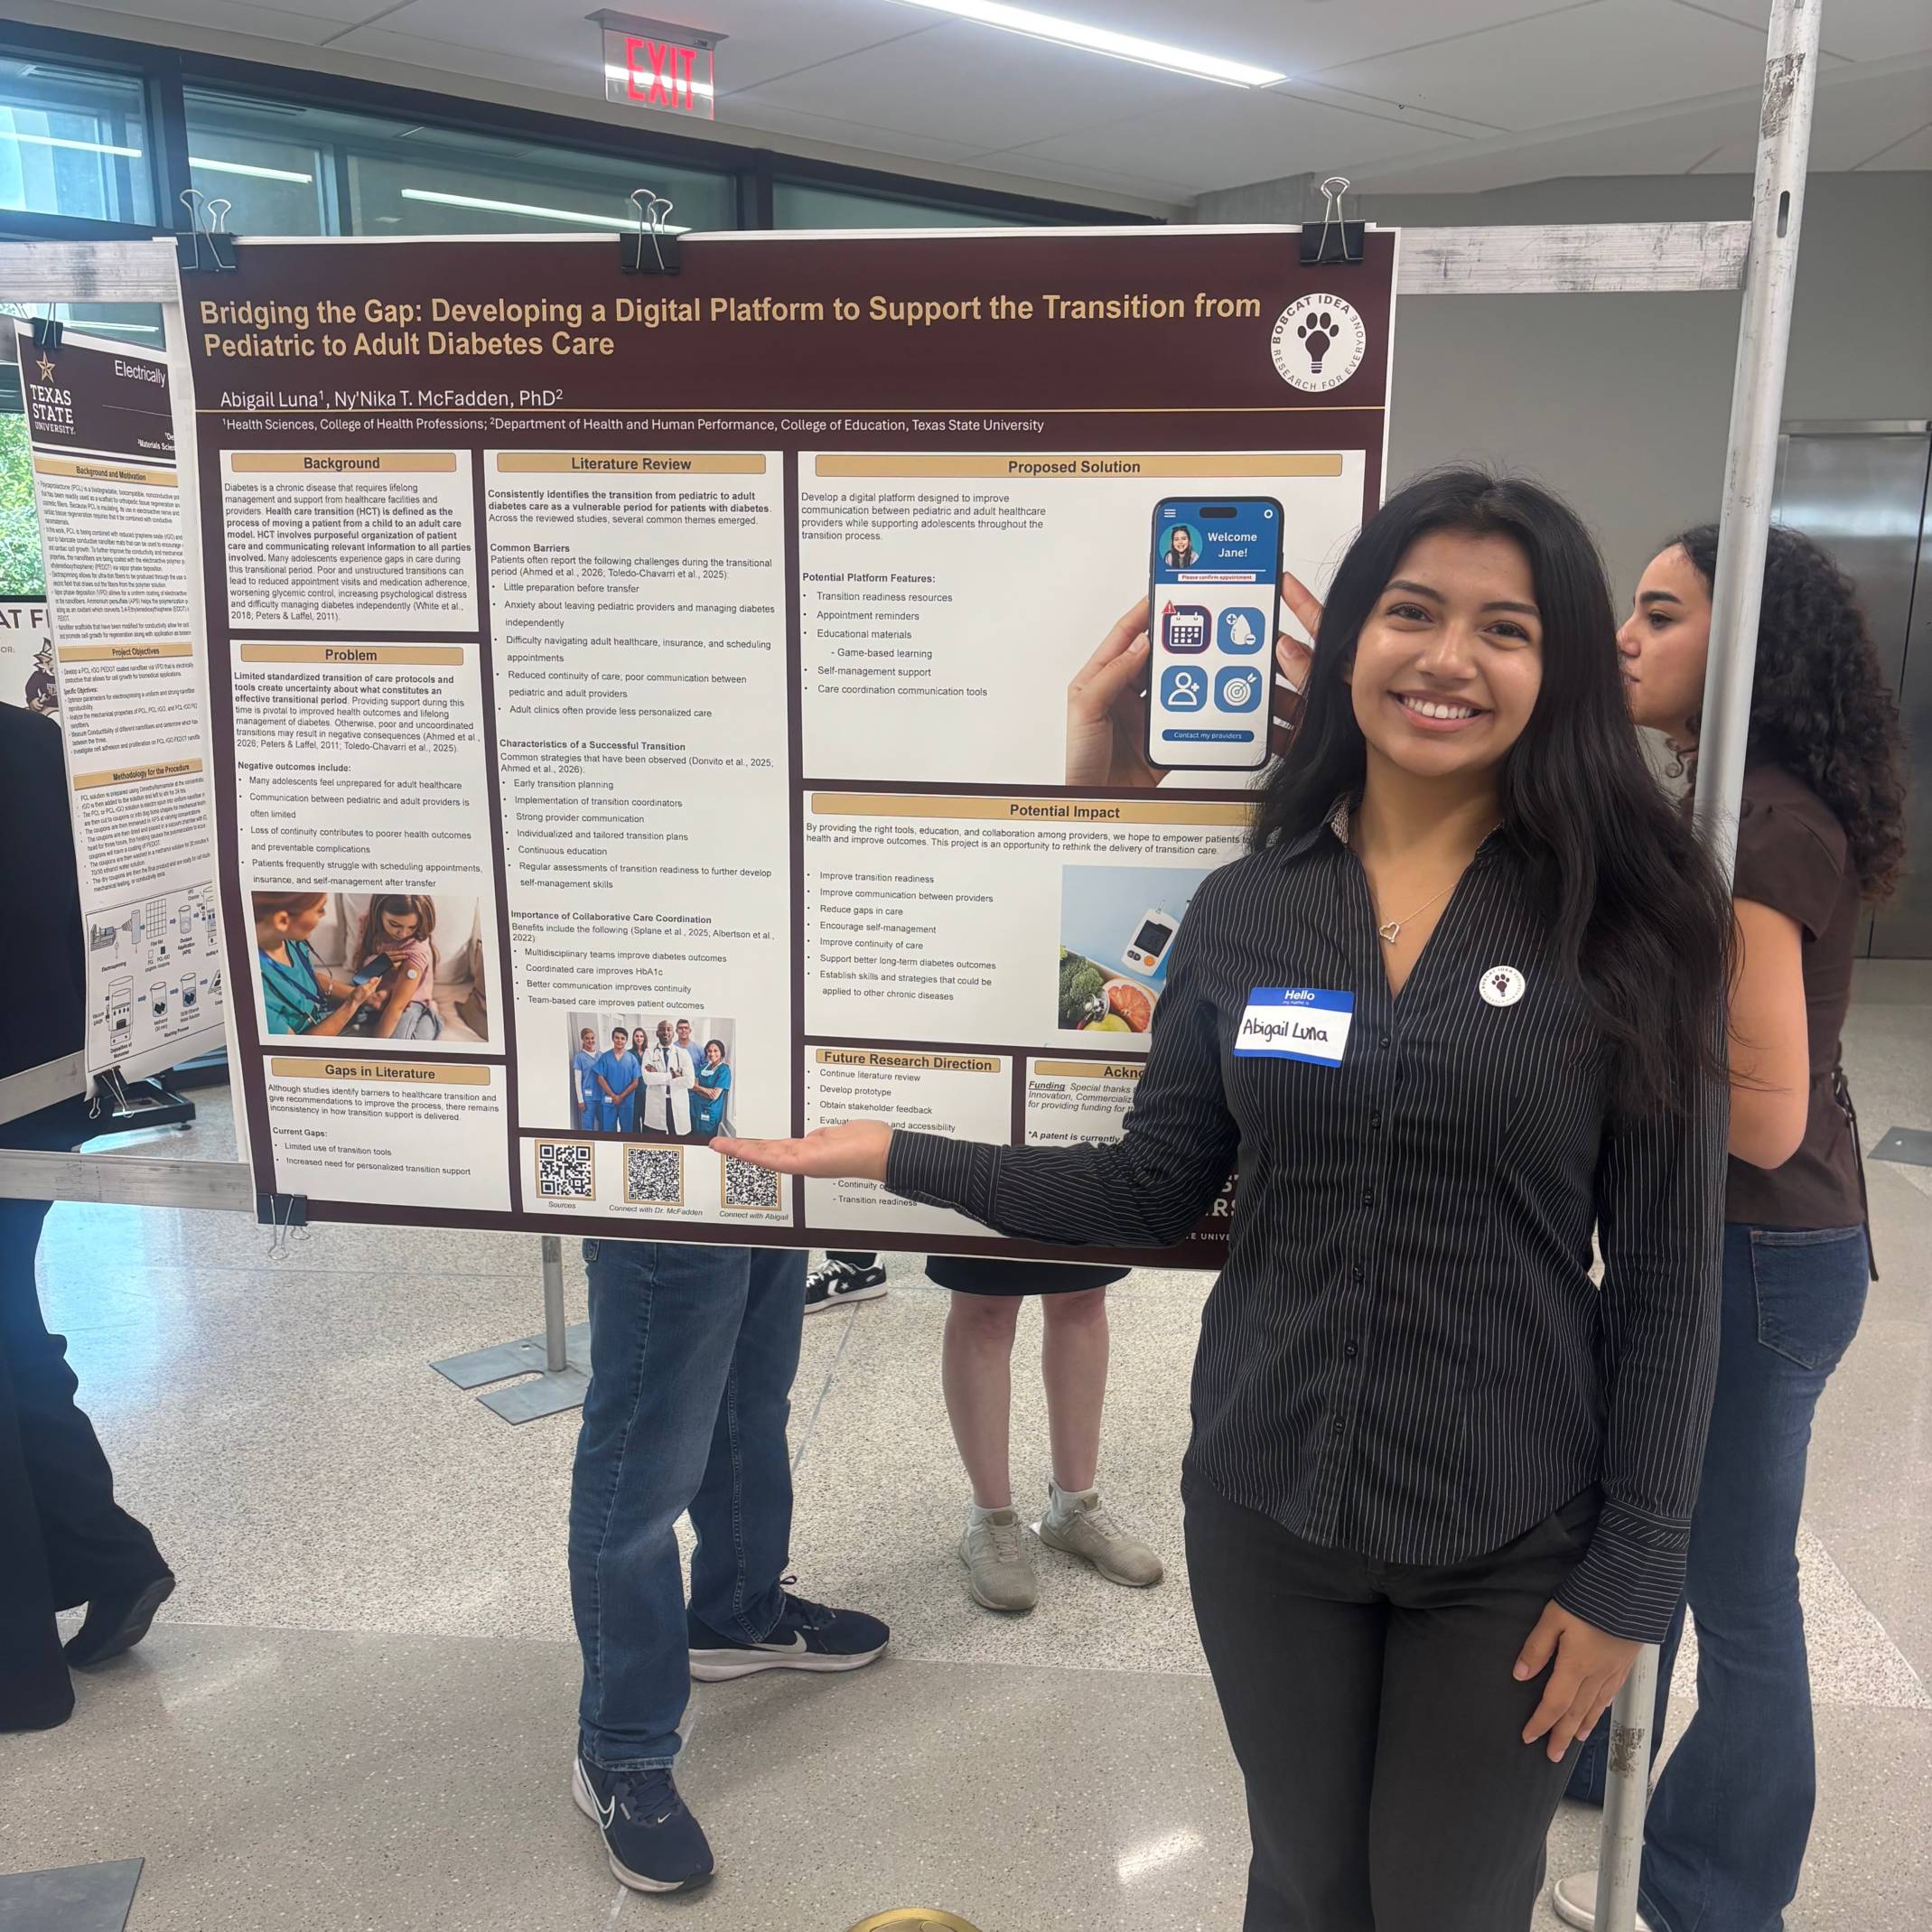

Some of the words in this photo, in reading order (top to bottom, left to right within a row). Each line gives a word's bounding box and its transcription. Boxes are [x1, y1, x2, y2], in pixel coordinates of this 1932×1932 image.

[624, 36, 697, 112] EXIT
[200, 300, 309, 329] Bridging
[316, 300, 356, 323] the
[364, 298, 421, 328] Gap:
[432, 298, 582, 327] Developing
[591, 303, 606, 322] a
[615, 297, 700, 327] Digital
[711, 296, 824, 322] Platform
[833, 297, 860, 321] to
[869, 295, 981, 325] Support
[989, 294, 1033, 319] the
[1042, 294, 1184, 319] Transition
[1194, 292, 1260, 317] from
[1273, 296, 1311, 344] BOBCAT
[1319, 294, 1350, 314] IDEA
[203, 333, 315, 357] Pediatric
[322, 334, 346, 356] to
[353, 331, 420, 356] Adult
[427, 331, 543, 355] Diabetes
[552, 331, 614, 355] Care
[1274, 350, 1316, 390] RESEARCH
[1322, 376, 1344, 389] FOR
[1344, 315, 1364, 374] EVERYONE
[115, 360, 166, 388] Electrically
[30, 384, 71, 406] TEXAS
[219, 391, 275, 410] Abigail
[334, 390, 396, 410] Ny'Nika
[398, 390, 413, 410] T.
[417, 389, 514, 409] McFadden,
[33, 403, 74, 425] STATE
[265, 418, 317, 431] Sciences,
[320, 418, 361, 432] College
[363, 418, 374, 430] of
[377, 419, 414, 430] Health
[415, 419, 488, 432] Professions;
[569, 419, 580, 430] of
[583, 419, 623, 430] Health
[626, 418, 649, 430] and
[651, 418, 695, 430] Human
[697, 418, 778, 431] Performance,
[780, 418, 826, 433] College
[829, 419, 842, 431] of
[845, 418, 909, 432] Education,
[911, 419, 946, 431] Texas
[948, 419, 980, 431] State
[983, 418, 1044, 434] University
[303, 456, 379, 472] Background
[571, 457, 638, 470] Literature
[642, 457, 691, 470] Review
[1008, 460, 1077, 476] Proposed
[1080, 460, 1140, 472] Solution
[76, 466, 108, 477] Background
[119, 471, 146, 481] Motivation
[224, 482, 258, 492] Diabetes
[275, 483, 304, 491] chronic
[305, 483, 336, 492] disease
[338, 483, 353, 491] that
[355, 484, 387, 493] requires
[389, 482, 418, 493] lifelong
[1208, 532, 1257, 542] Welcome
[490, 544, 531, 552] Common
[533, 543, 570, 552] Barriers
[1218, 547, 1247, 557] Jane!
[802, 572, 845, 582] Potential
[847, 573, 888, 582] Platform
[891, 574, 935, 583] Features:
[817, 591, 860, 601] Transition
[863, 593, 906, 602] readiness
[817, 610, 873, 621] Appointment
[874, 611, 919, 621] reminders
[817, 629, 869, 639] Educational
[871, 630, 912, 639] materials
[112, 649, 132, 658] Project
[132, 648, 159, 657] Objectives
[325, 649, 378, 661] Problem
[837, 648, 894, 658] Game-based
[897, 649, 932, 660] learning
[817, 666, 896, 677] Self-management
[898, 668, 931, 678] support
[499, 739, 567, 748] Characteristics
[569, 740, 579, 749] of
[589, 740, 639, 750] Successful
[640, 742, 686, 751] Transition
[113, 770, 147, 780] Methodology
[164, 764, 190, 773] Procedure
[238, 761, 273, 771] Negative
[275, 762, 315, 770] outcomes
[317, 763, 350, 772] include:
[1010, 804, 1069, 817] Potential
[1074, 805, 1120, 820] Impact
[819, 871, 853, 881] Improve
[854, 873, 892, 882] transition
[894, 874, 934, 883] readiness
[511, 910, 559, 921] Importance
[561, 911, 570, 919] of
[572, 912, 630, 921] Collaborative
[632, 913, 654, 921] Care
[655, 914, 712, 924] Coordination
[1284, 990, 1315, 1001] Hello
[1243, 1017, 1289, 1042] Abigail
[1292, 1022, 1328, 1041] Luna
[824, 1051, 865, 1064] Future
[870, 1053, 929, 1068] Research
[934, 1057, 992, 1070] Direction
[325, 1064, 357, 1078] Gaps
[361, 1066, 371, 1077] in
[376, 1067, 435, 1078] Literature
[819, 1069, 855, 1078] Continue
[857, 1070, 892, 1080] literature
[894, 1073, 920, 1082] review
[819, 1084, 853, 1096] Develop
[854, 1087, 891, 1097] prototype
[819, 1100, 845, 1109] Obtain
[847, 1103, 894, 1112] stakeholder
[895, 1105, 932, 1115] feedback
[273, 1127, 303, 1136] Current
[303, 1129, 328, 1138] Gaps:
[548, 1199, 576, 1209] Sources
[609, 1204, 638, 1212] Connect
[639, 1205, 653, 1213] with
[666, 1206, 703, 1216] McFadden
[719, 1208, 748, 1218] Connect
[749, 1209, 763, 1218] with
[764, 1209, 789, 1221] Abigail
